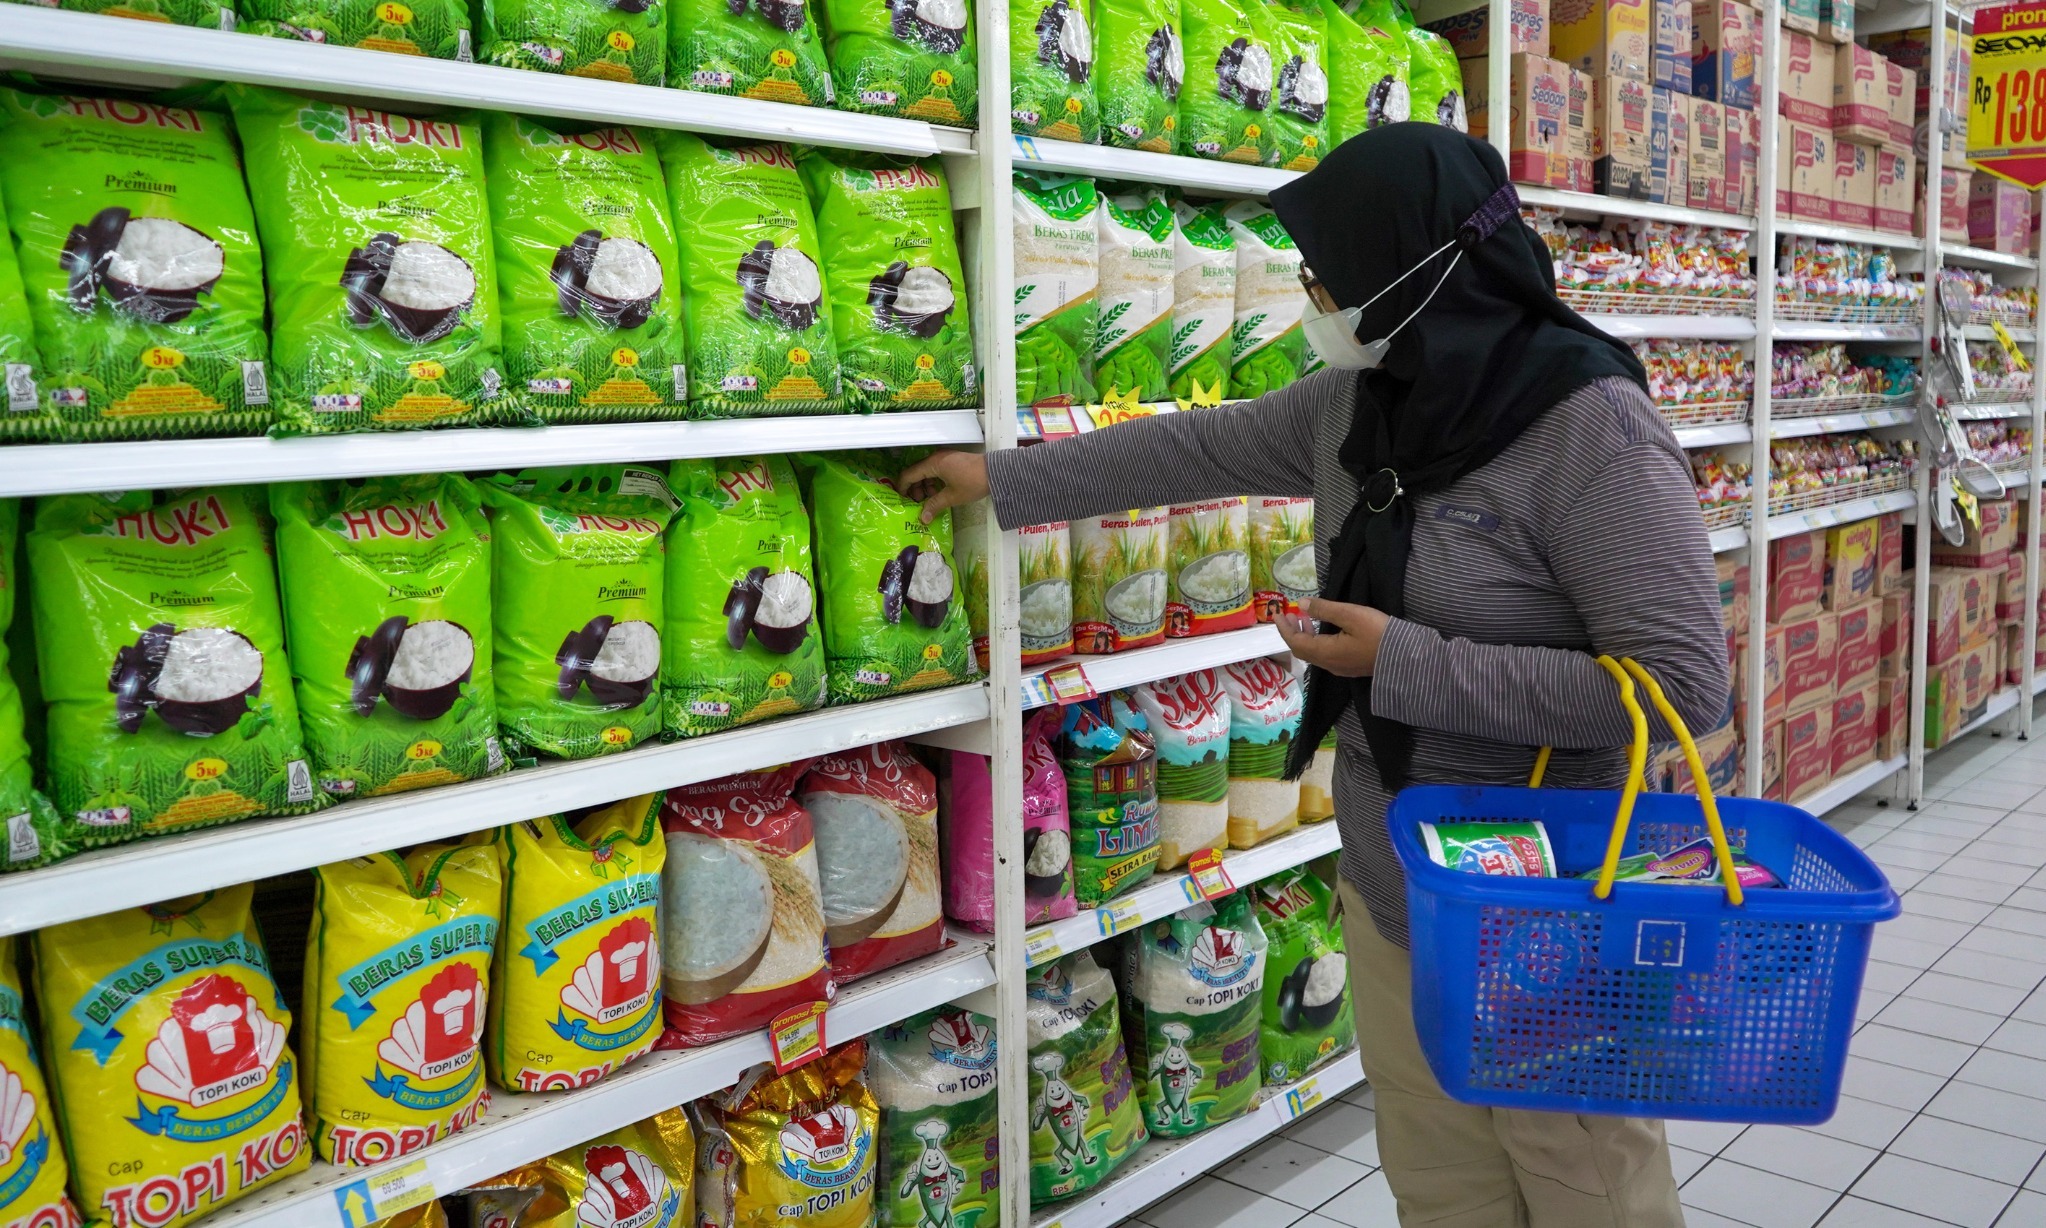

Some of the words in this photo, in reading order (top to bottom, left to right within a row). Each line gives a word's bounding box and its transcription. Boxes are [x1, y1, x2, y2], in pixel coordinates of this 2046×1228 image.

[1661, 14, 1672, 29] 24
[1531, 86, 1567, 107] Sedaap
[1975, 76, 1991, 113] Rp
[1585, 140, 1591, 151] 9
[1653, 130, 1666, 151] 40
[1581, 160, 1592, 181] 40
[104, 174, 177, 193] Premium
[757, 212, 798, 227] Premium
[1034, 225, 1068, 239] BERAS
[1132, 245, 1158, 258] BERAS
[1202, 265, 1225, 277] BERAS
[1266, 262, 1291, 274] BERAS
[1263, 498, 1288, 508] Beras
[1169, 505, 1197, 517] Beras
[1024, 523, 1050, 535] Pulen,
[1101, 518, 1129, 529] Beras
[150, 591, 215, 605] Premium
[388, 585, 444, 598] Premium
[598, 585, 648, 598] Premium
[290, 789, 311, 797] HALAL
[688, 786, 718, 795] BERAS
[1110, 858, 1139, 880] SETRA
[1190, 855, 1211, 869] promosi
[536, 898, 603, 946] BERAS
[608, 880, 655, 914] SUPER
[349, 943, 425, 997] BERAS
[430, 922, 482, 959] SUPER
[85, 962, 166, 1025] BERAS
[166, 940, 241, 973] SUPER
[1186, 996, 1205, 1007] Cap
[1207, 989, 1234, 1006] TOPI
[1236, 977, 1260, 997] KOKI
[603, 1007, 625, 1020] TOPI
[627, 996, 645, 1011] KOKI
[773, 1009, 810, 1030] promosi
[1042, 1017, 1059, 1029] Cap
[580, 1034, 614, 1047] BERAS
[526, 1050, 554, 1065] Cap
[427, 1059, 453, 1076] TOPI
[198, 1084, 228, 1101] TOPI
[232, 1071, 262, 1090] KOKI
[937, 1082, 958, 1094] Cap
[960, 1074, 993, 1092] TOPI
[401, 1092, 440, 1106] BERAS
[174, 1122, 221, 1137] BERAS
[333, 1123, 439, 1166] TOPI
[108, 1159, 144, 1177] Cap
[382, 1176, 406, 1195] 69.500
[805, 1172, 832, 1185] BERAS
[102, 1155, 228, 1228] TOPI
[778, 1205, 803, 1217] Cap
[807, 1188, 845, 1214] TOPI
[850, 1166, 875, 1199] KOKI
[1052, 1183, 1069, 1196] BPS
